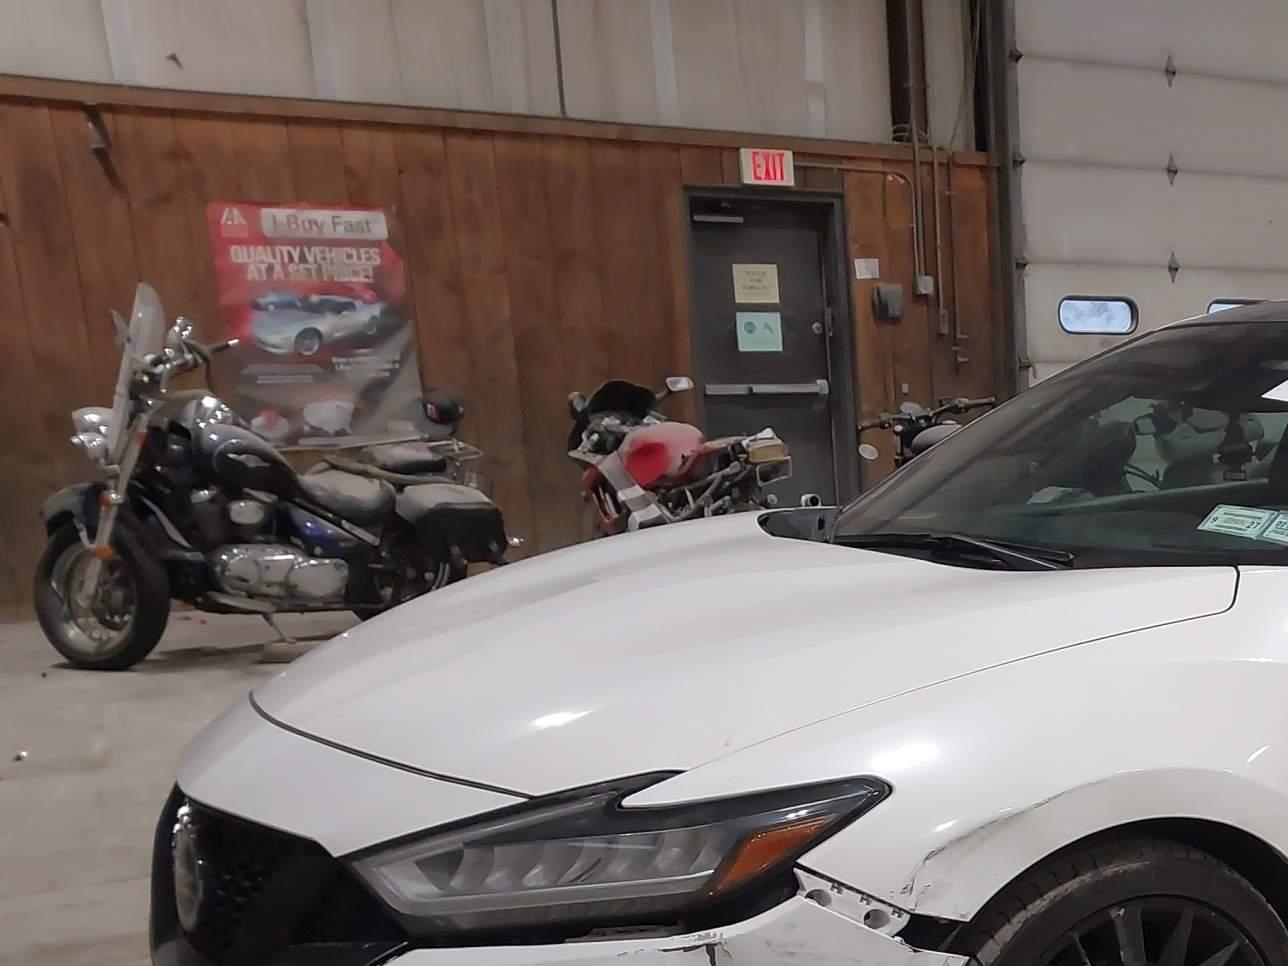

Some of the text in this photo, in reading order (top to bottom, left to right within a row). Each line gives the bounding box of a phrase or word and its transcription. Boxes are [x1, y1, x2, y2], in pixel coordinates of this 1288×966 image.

[752, 151, 785, 181] EXIT
[331, 215, 373, 234] Fast
[229, 245, 301, 263] QUALITY
[247, 264, 268, 281] AT
[272, 264, 285, 281] A
[288, 264, 318, 281] SET
